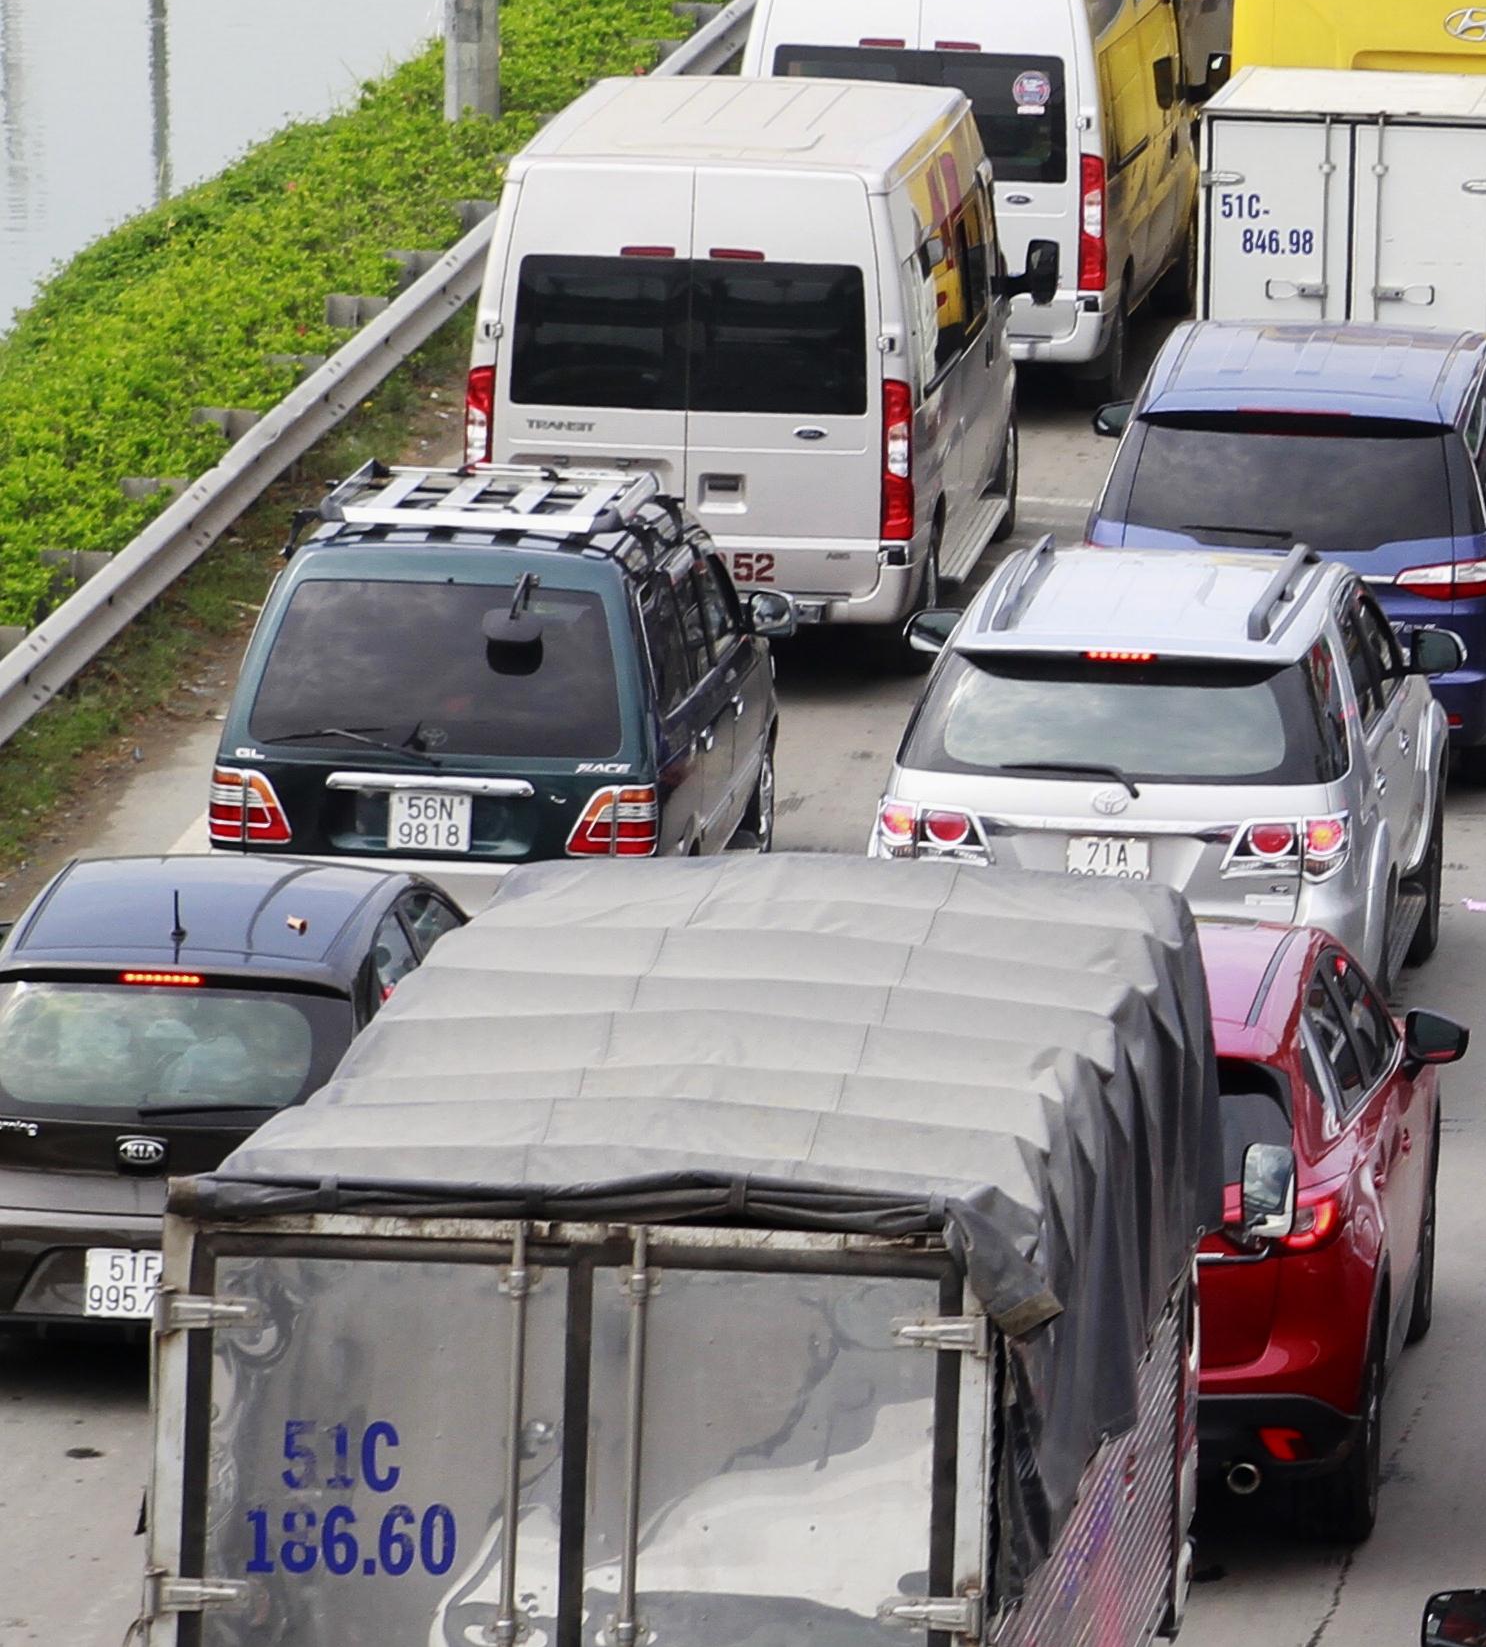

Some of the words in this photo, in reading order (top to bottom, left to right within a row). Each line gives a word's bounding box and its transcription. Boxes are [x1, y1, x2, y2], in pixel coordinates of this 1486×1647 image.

[1242, 228, 1314, 255] 846.98
[526, 417, 597, 433] TRANSIT
[234, 747, 266, 760] GL
[408, 796, 454, 821] 56N
[398, 823, 460, 847] 9818
[1087, 842, 1128, 868] 71A
[127, 1144, 157, 1158] KIA
[110, 1255, 160, 1284] 51F
[280, 1419, 402, 1493] 51C
[244, 1502, 457, 1577] 186.60
